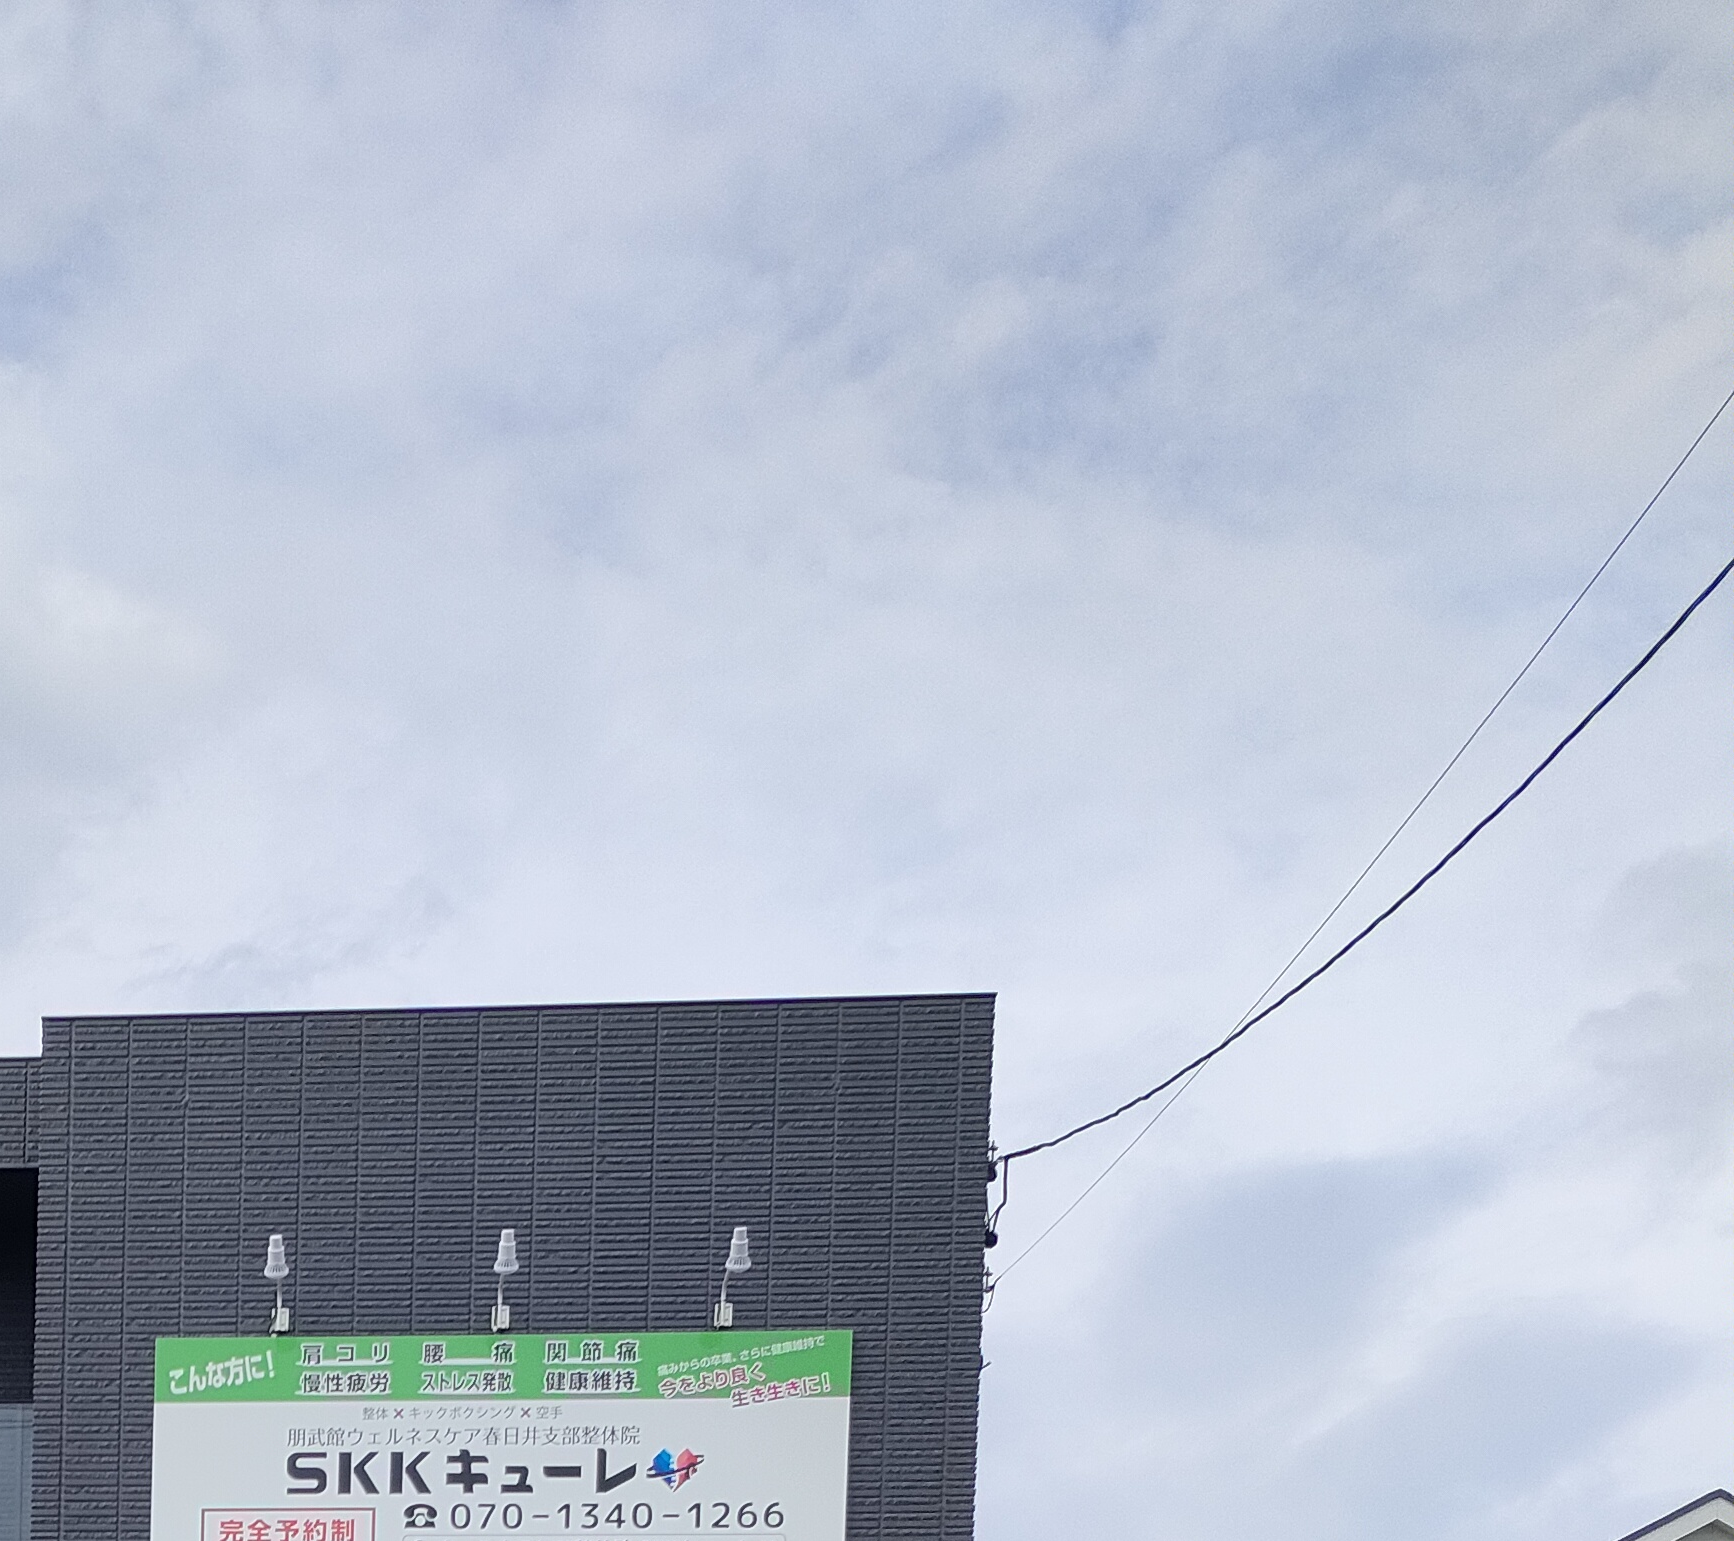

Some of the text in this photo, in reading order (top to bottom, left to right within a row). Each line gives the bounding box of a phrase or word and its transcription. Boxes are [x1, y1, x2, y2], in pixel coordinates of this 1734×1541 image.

[545, 1340, 639, 1363] 関節痛
[300, 1369, 636, 1394] 慢性疲労 ストレス発散 健康維持
[658, 1361, 767, 1399] 今をより良く
[287, 1425, 642, 1447] 朋武館ウェルネスケア春日井支部整体院
[285, 1448, 638, 1496] SKKキューレ
[449, 1501, 785, 1530] 070-1340-1266
